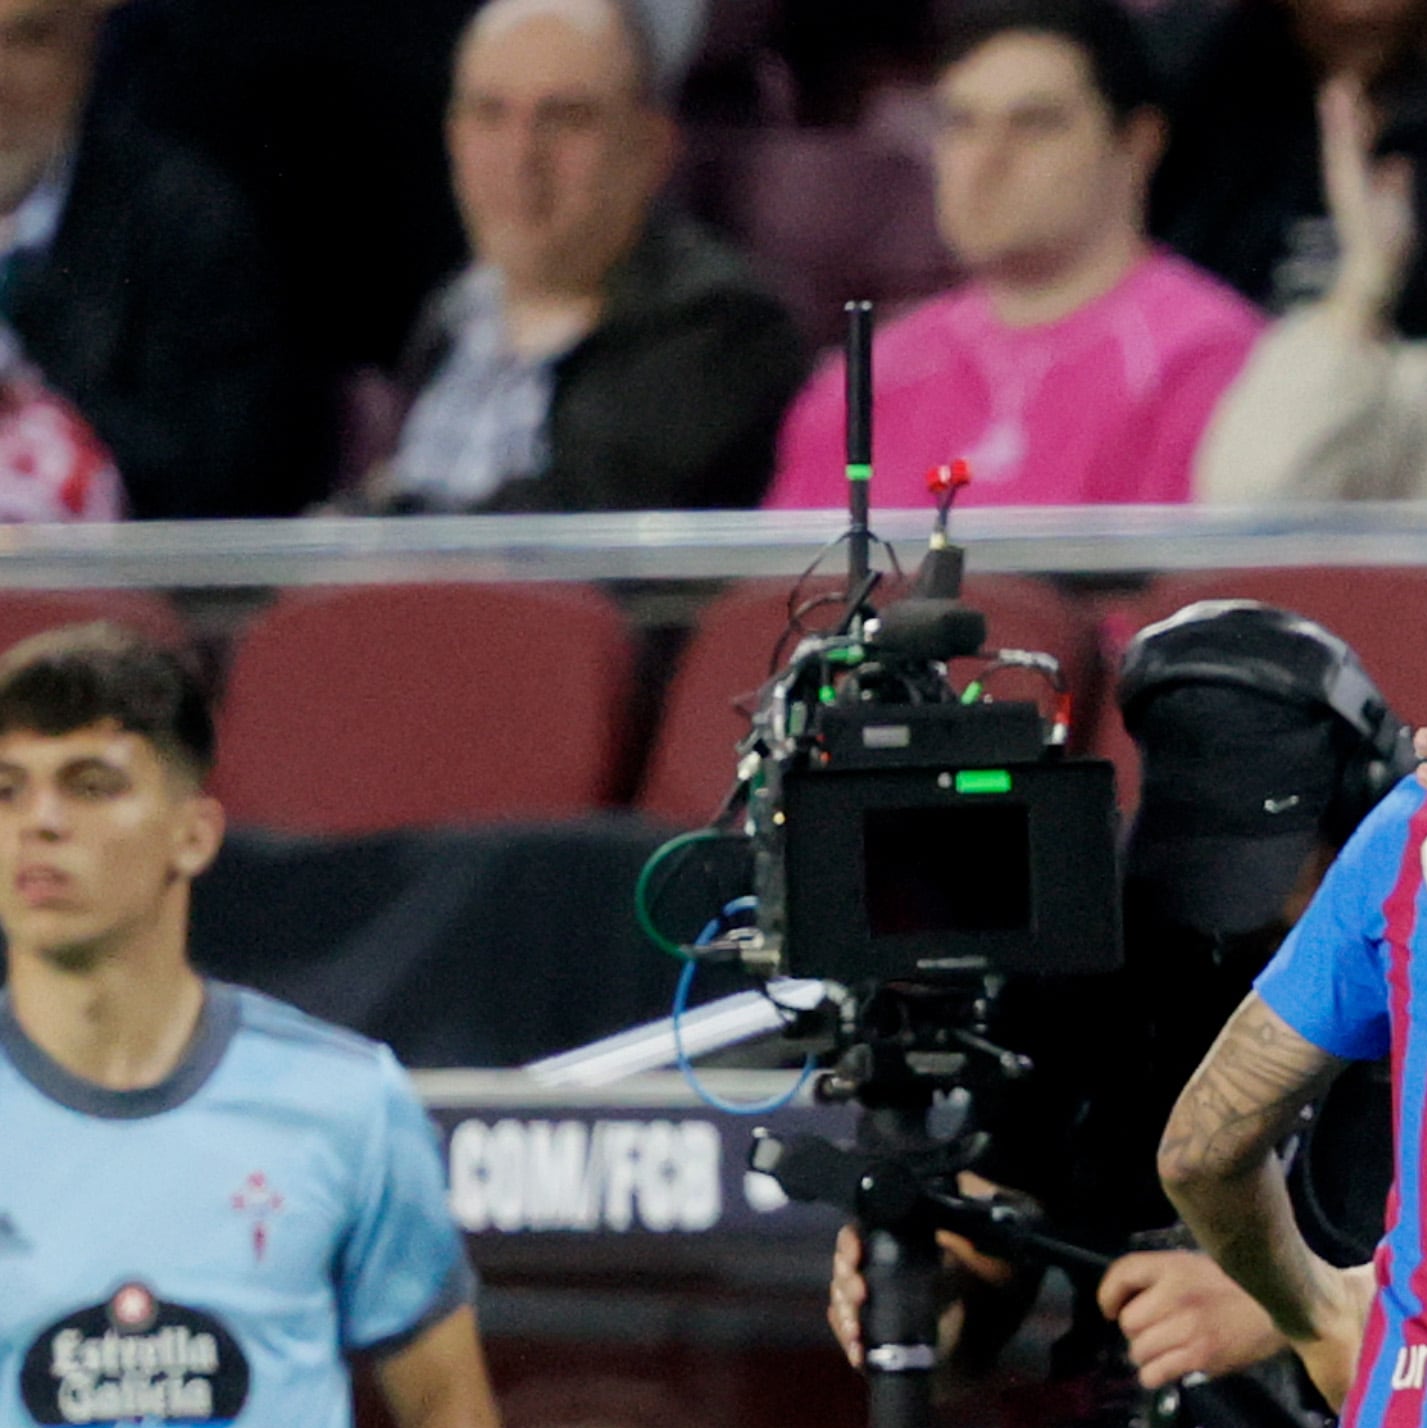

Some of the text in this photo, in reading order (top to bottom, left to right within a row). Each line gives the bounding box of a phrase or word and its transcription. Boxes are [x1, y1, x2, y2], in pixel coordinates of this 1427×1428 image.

[449, 1118, 721, 1232] COM/FCB
[51, 1326, 219, 1378] Estrella
[57, 1370, 213, 1424] Galicia
